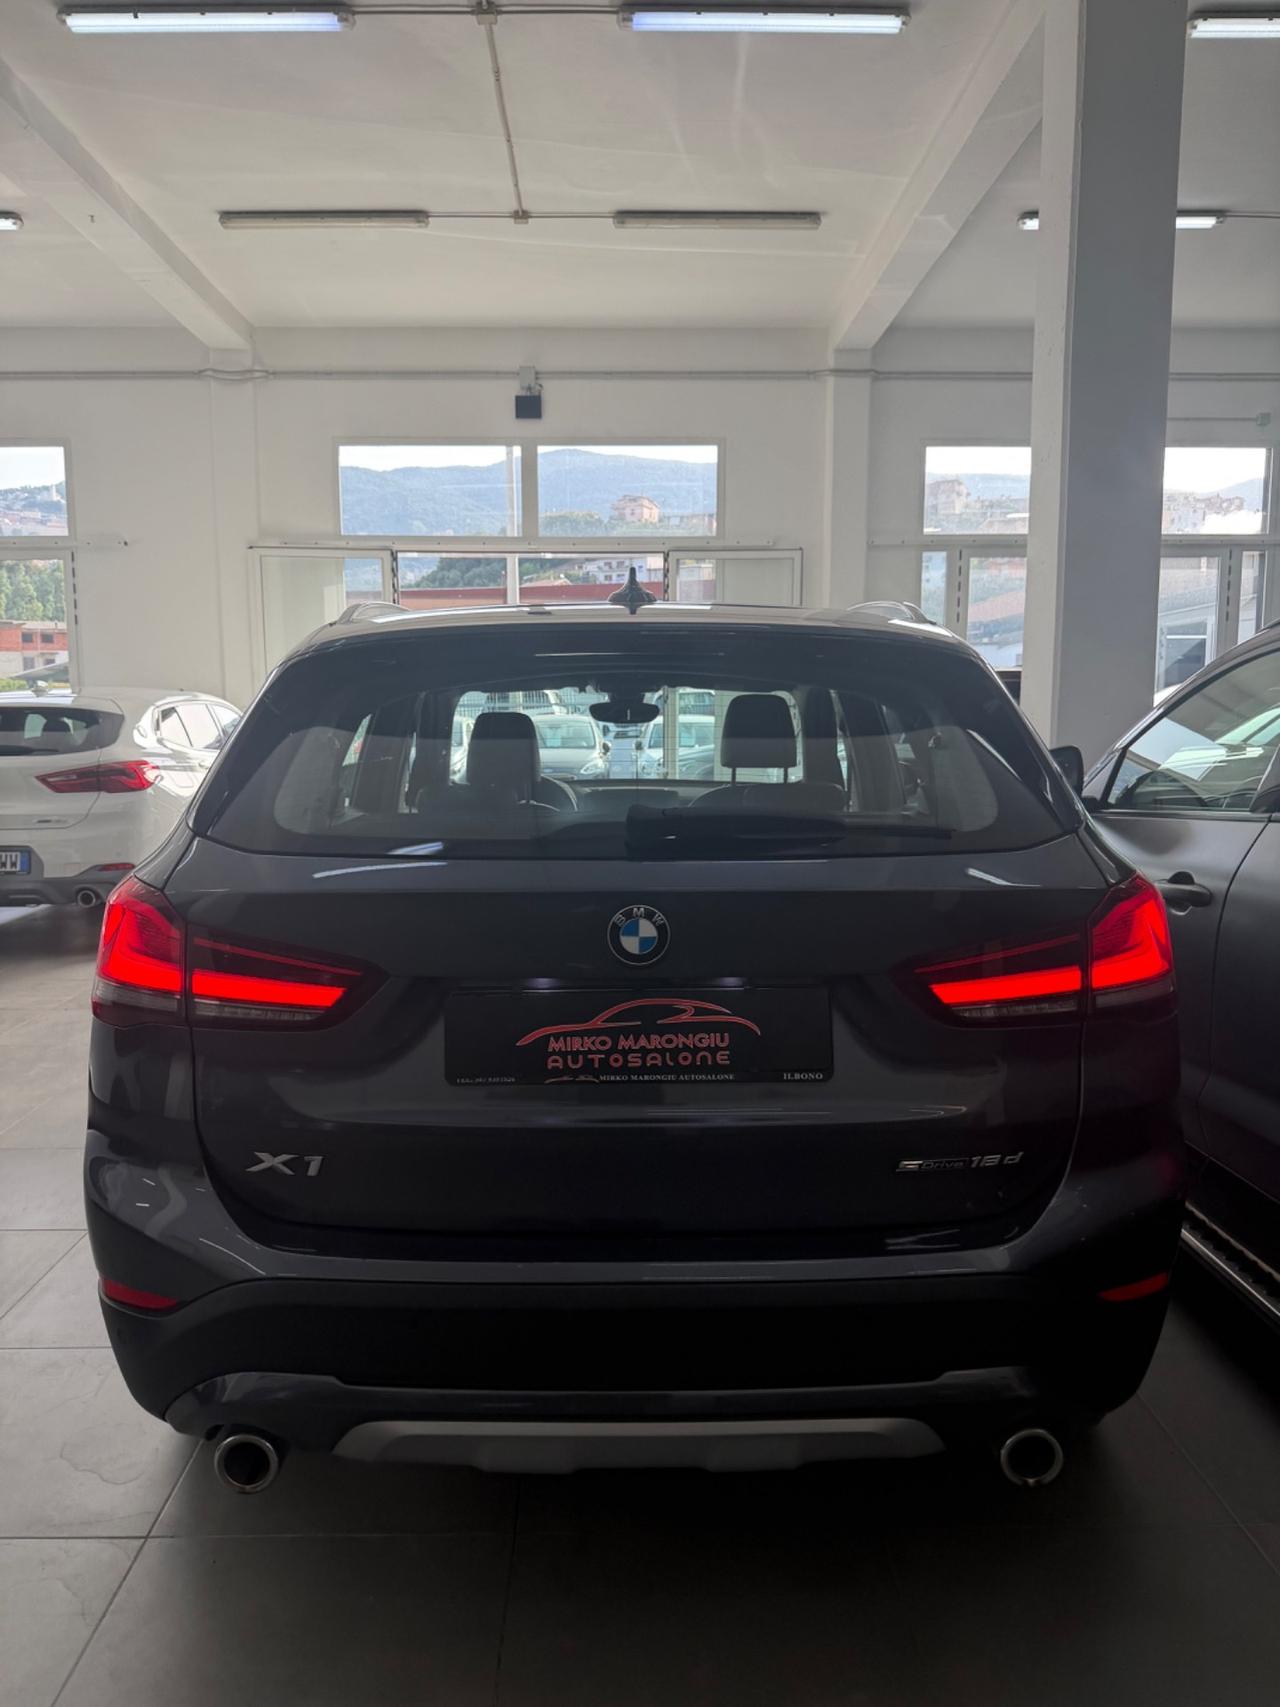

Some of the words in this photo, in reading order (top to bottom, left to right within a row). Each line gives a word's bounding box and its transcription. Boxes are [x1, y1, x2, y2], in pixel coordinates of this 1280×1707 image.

[614, 907, 664, 927] BMW
[547, 1036, 612, 1052] MIRKO
[617, 1033, 730, 1050] MARONGIU
[547, 1051, 730, 1070] AUTOSALONE
[783, 1072, 823, 1080] ILBONO
[245, 1151, 324, 1176] X1
